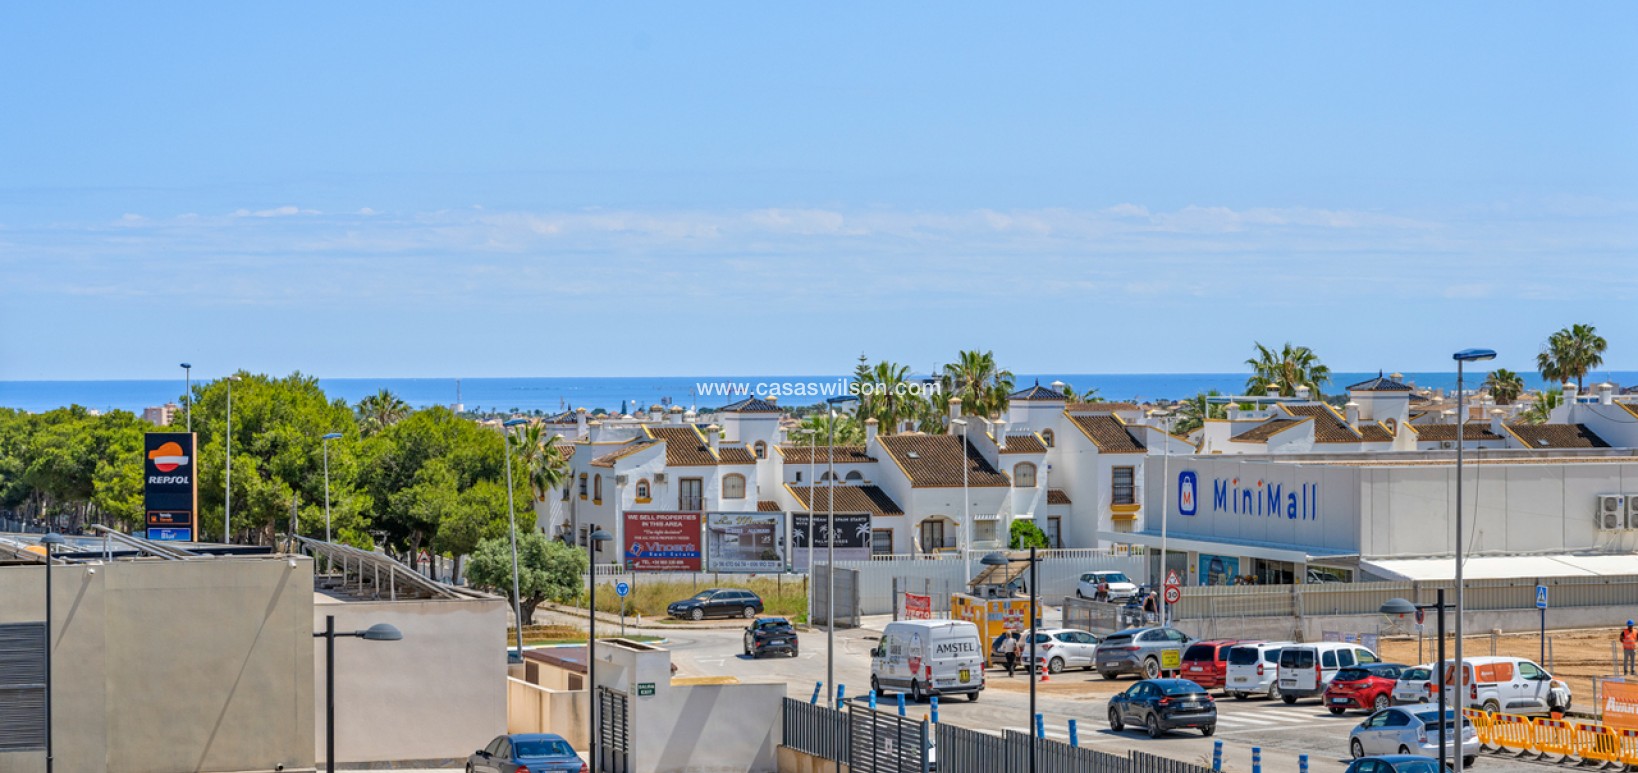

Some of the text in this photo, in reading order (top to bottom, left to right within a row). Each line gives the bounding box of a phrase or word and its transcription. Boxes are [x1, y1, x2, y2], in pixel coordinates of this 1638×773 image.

[148, 476, 189, 484] REPSOL
[1213, 477, 1318, 521] MiniMall
[936, 642, 975, 654] AMSTEL
